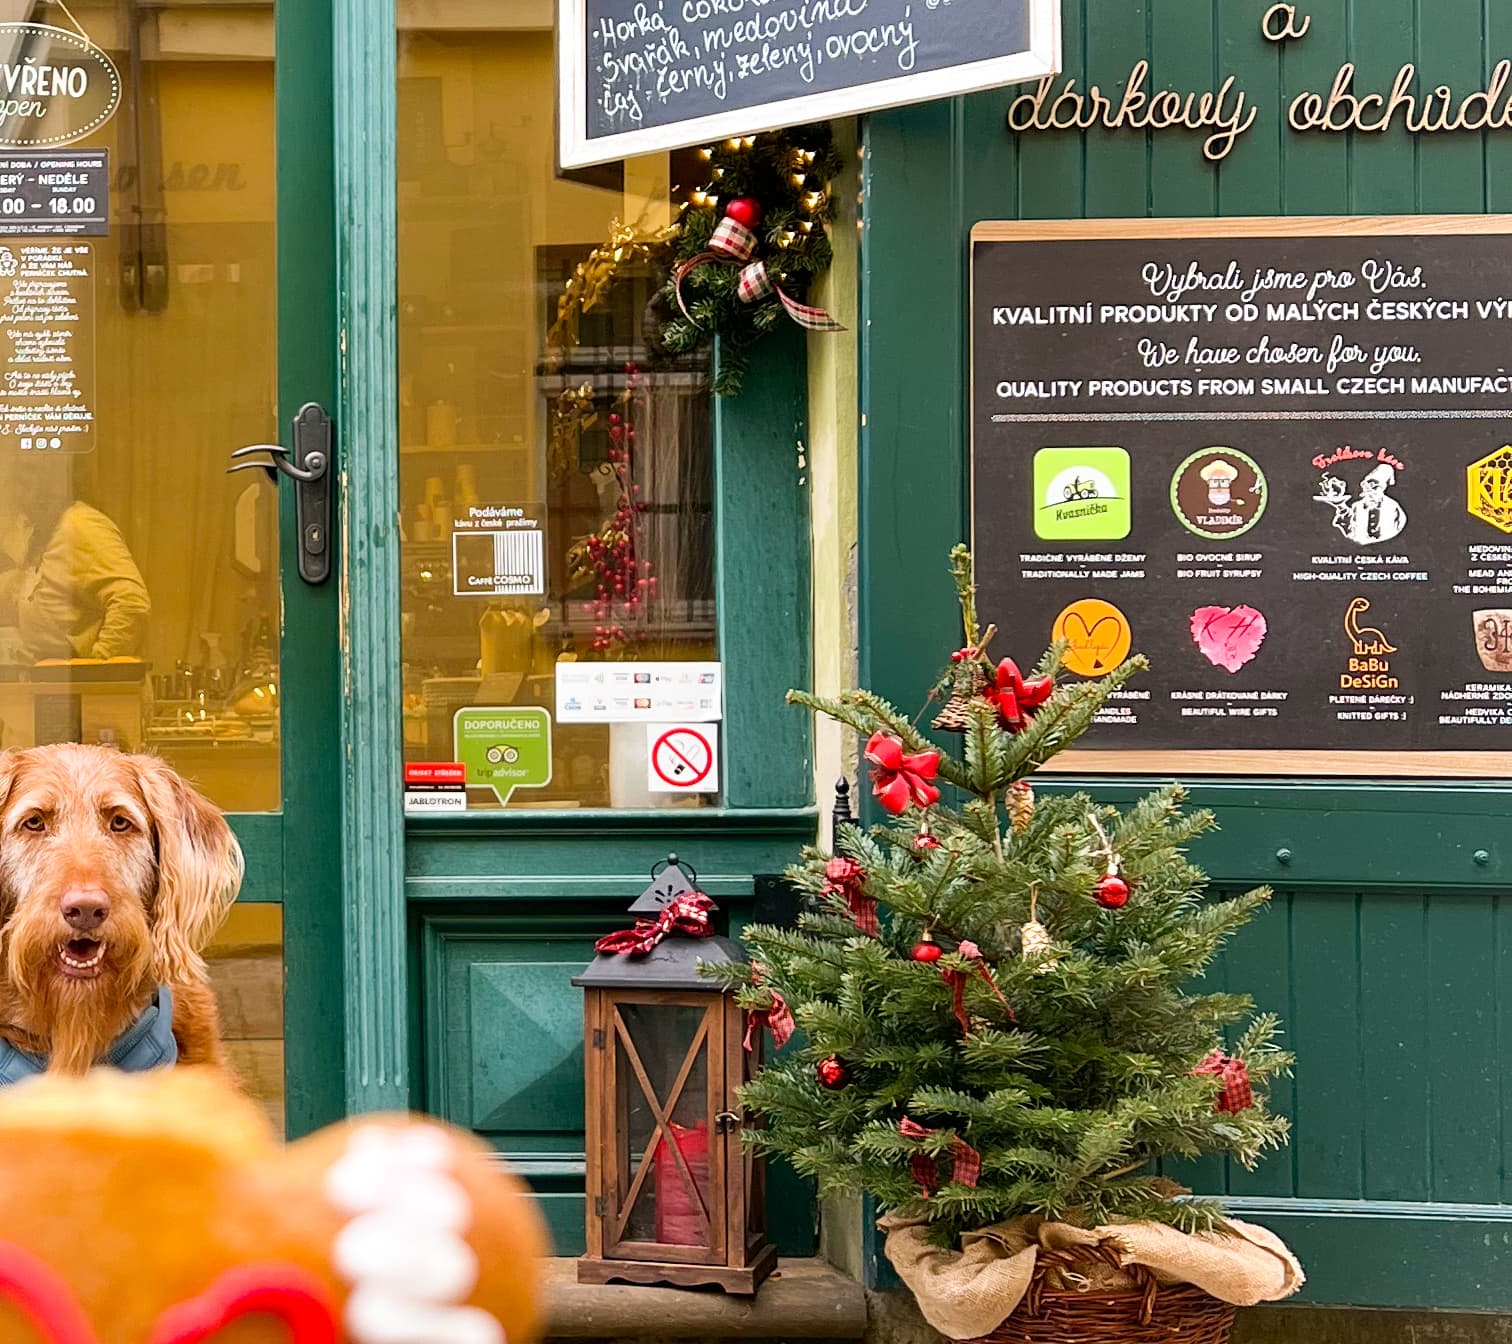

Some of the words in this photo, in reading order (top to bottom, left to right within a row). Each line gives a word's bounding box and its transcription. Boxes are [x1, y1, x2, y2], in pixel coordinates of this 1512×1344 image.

[1262, 2, 1311, 42] a
[1007, 60, 1257, 161] dárkový
[1288, 59, 1512, 133] obchůd
[10, 161, 32, 169] DOBA
[40, 160, 75, 169] OPENING
[76, 160, 102, 168] HOURS
[38, 171, 88, 185] NEDĚLE
[48, 197, 96, 214] 18.00
[1141, 259, 1244, 304] Vybrali
[1240, 268, 1308, 303] jsme
[1306, 269, 1356, 301] pro
[1361, 259, 1428, 294] Vás.
[992, 302, 1094, 325] KVALITNÍ
[1100, 304, 1218, 324] PRODUKTY
[1225, 303, 1259, 323] OD
[1266, 299, 1360, 322] MALÝCH
[1366, 296, 1470, 320] ČESKÝCH
[1137, 338, 1181, 368] We
[1184, 335, 1241, 365] have
[1245, 335, 1324, 364] chosen
[1326, 333, 1369, 374] for
[1369, 344, 1423, 375] you.
[996, 381, 1083, 398] QUALITY
[1088, 379, 1193, 397] PRODUCTS
[1198, 379, 1255, 396] FROM
[1261, 378, 1330, 395] SMALL
[1336, 377, 1406, 395] CZECH
[469, 507, 524, 518] Podáváme
[1177, 553, 1193, 561] BIO
[1236, 553, 1262, 561] SIRUP
[1022, 570, 1089, 579] TRADITIONALLY
[1092, 570, 1117, 579] MADE
[1119, 570, 1145, 579] JAMS
[1177, 570, 1193, 578] BIO
[1195, 570, 1221, 578] FRUIT
[1293, 571, 1357, 581] HIGH-QUALITY
[1360, 571, 1390, 581] CZECH
[1392, 571, 1428, 581] COFFEE
[493, 575, 531, 585] COSMO
[1348, 658, 1389, 672] BaBu
[1340, 673, 1399, 689] DeSiGn
[1182, 707, 1226, 716] BEAUTIFUL
[1253, 707, 1278, 716] GIFTS
[1373, 712, 1399, 721] GIFTS
[464, 718, 540, 730] DOPORUČENO
[1439, 716, 1498, 724] BEAUTIFULLY
[477, 767, 527, 778] tripadvisor
[409, 797, 462, 805] JABLOTRON
